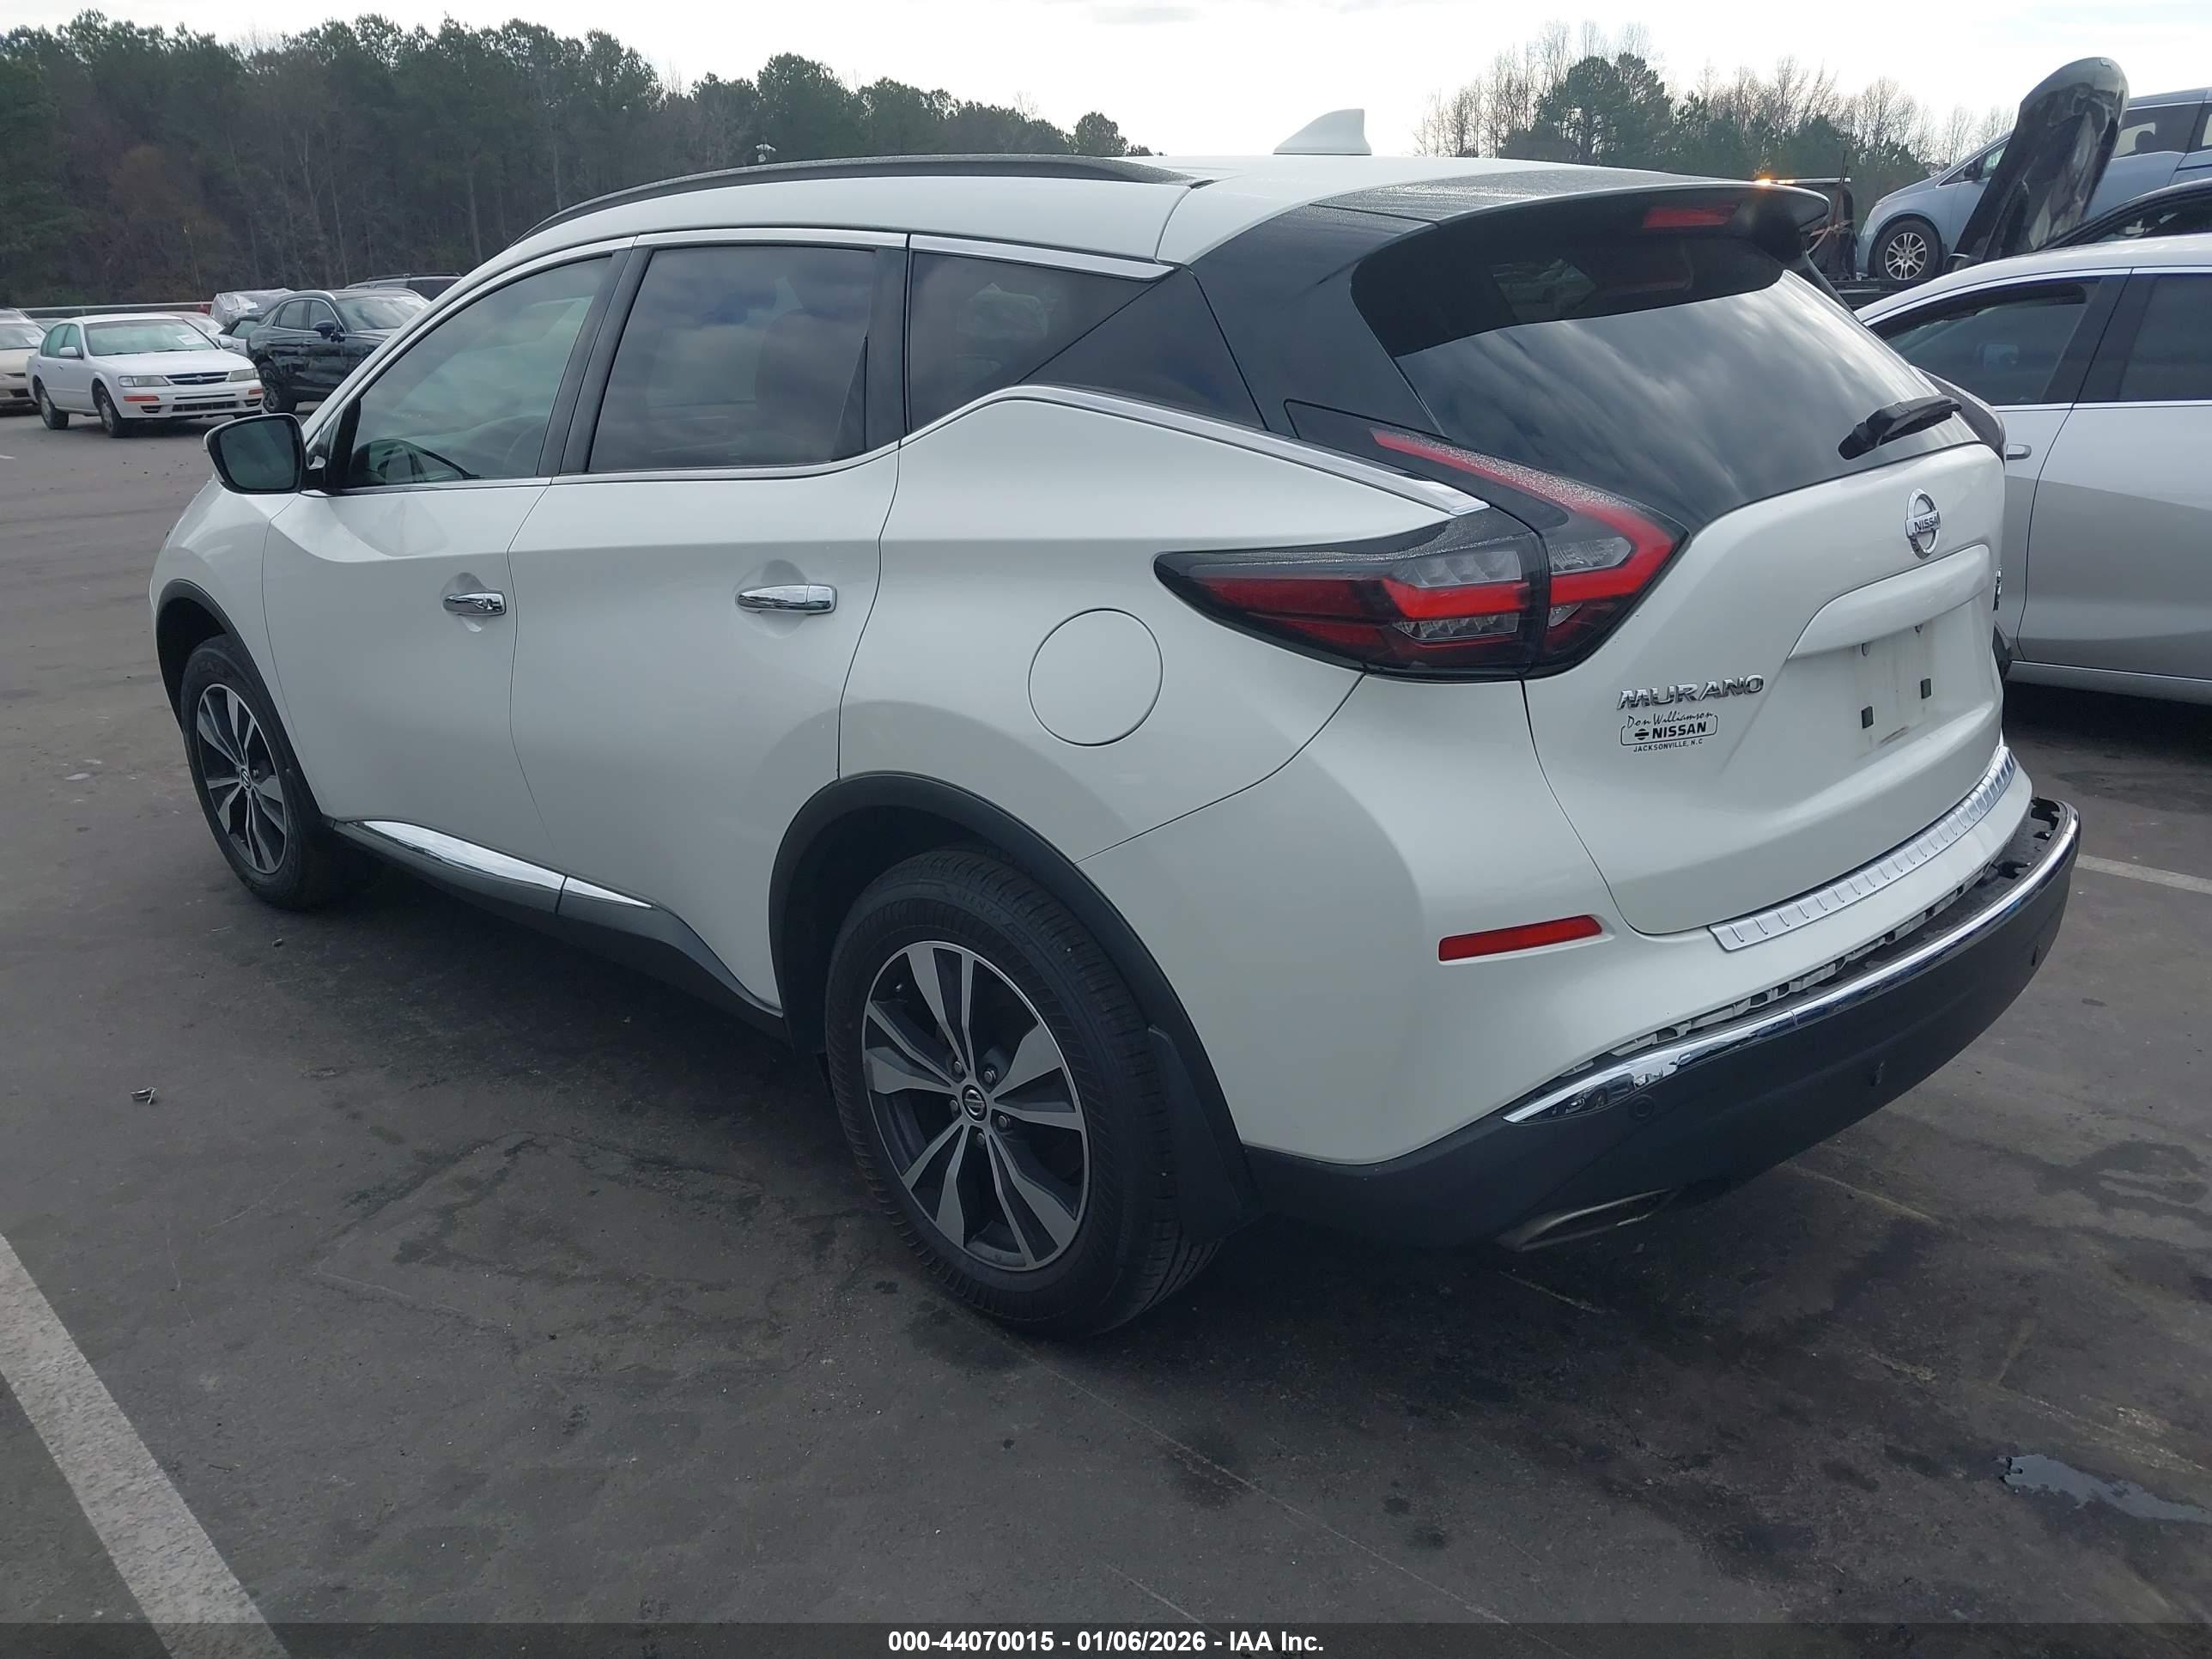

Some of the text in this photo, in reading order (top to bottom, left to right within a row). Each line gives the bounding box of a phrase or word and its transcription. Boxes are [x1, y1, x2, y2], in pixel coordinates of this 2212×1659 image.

[1914, 515, 1939, 532] NISSA
[1617, 674, 1765, 710] MURANO
[1627, 711, 1714, 729] Don Williamson
[1652, 721, 1707, 739] NISSAN
